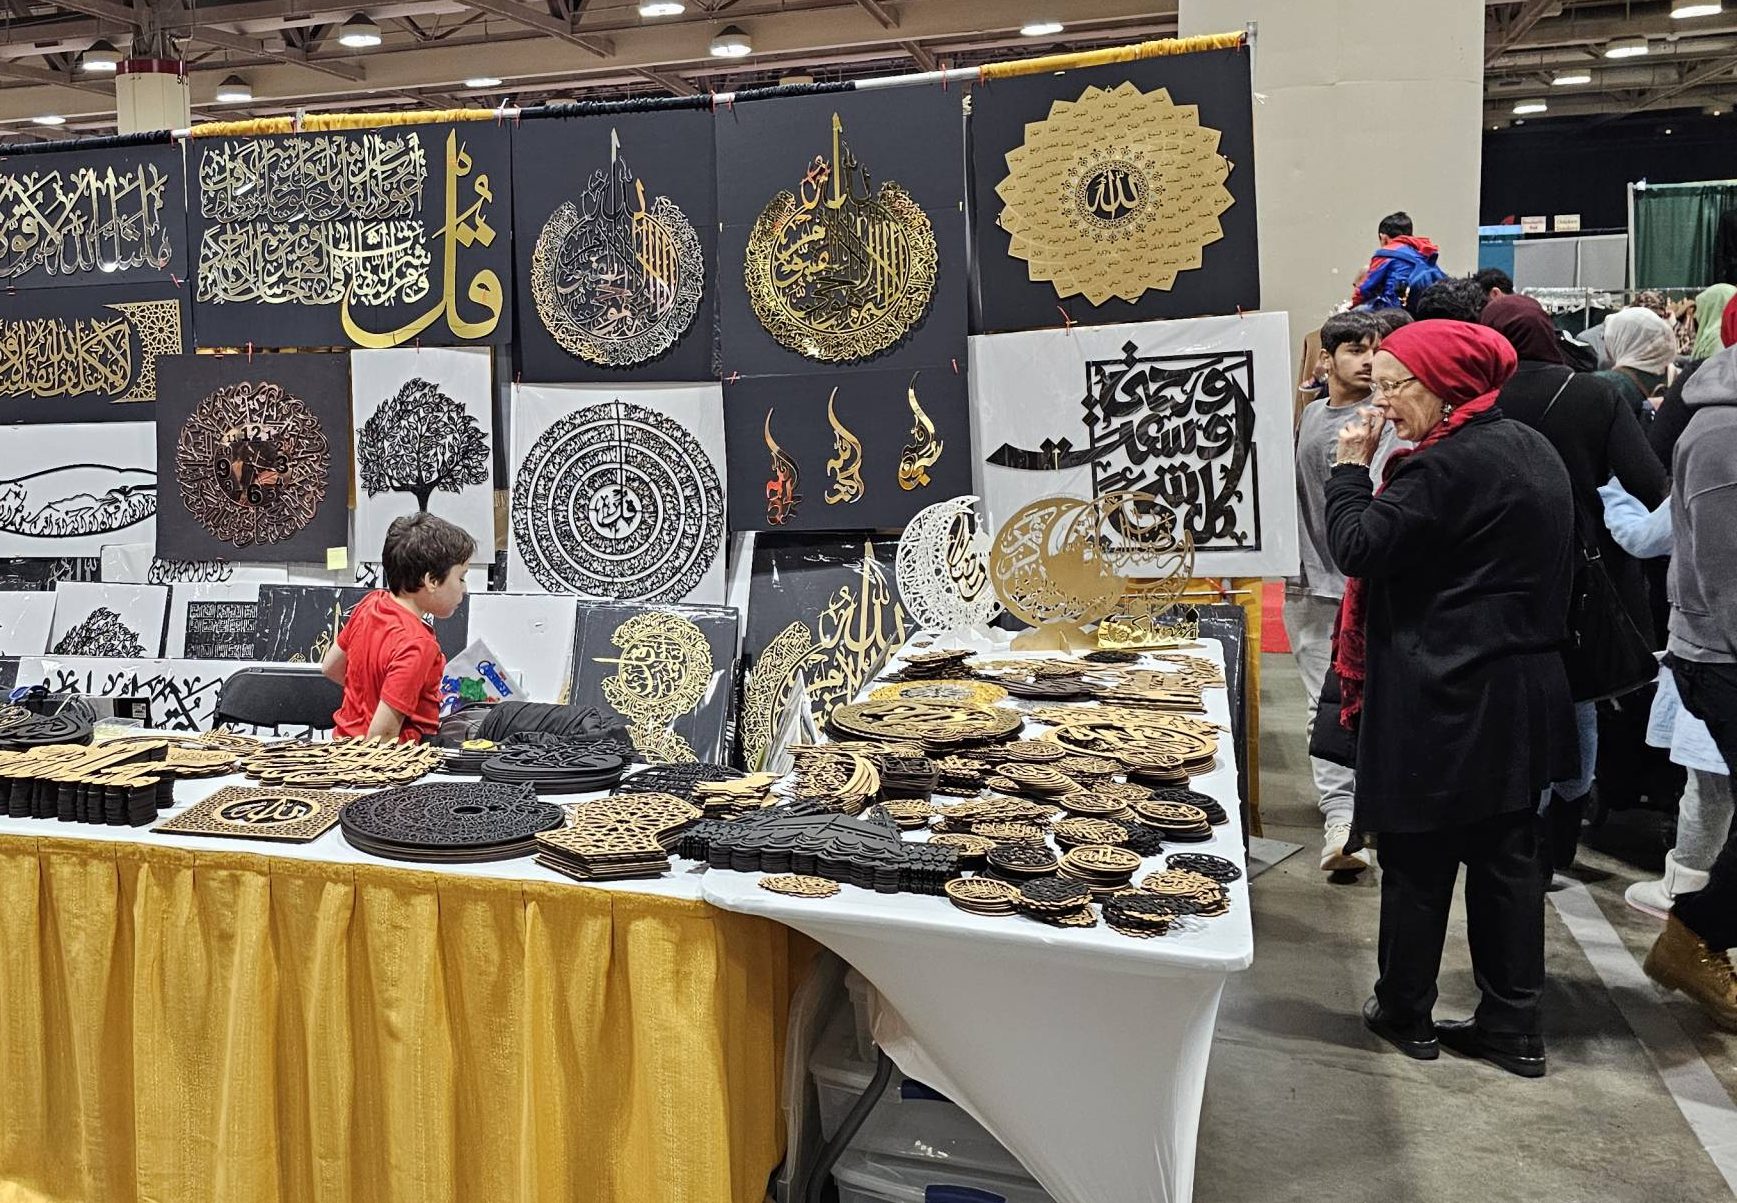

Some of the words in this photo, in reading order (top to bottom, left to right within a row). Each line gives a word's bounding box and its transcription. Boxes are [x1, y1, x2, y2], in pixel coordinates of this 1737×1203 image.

[341, 127, 503, 348] قل
[241, 425, 262, 442] 12
[217, 458, 231, 480] 9
[275, 454, 290, 474] 3
[247, 483, 263, 505] 6
